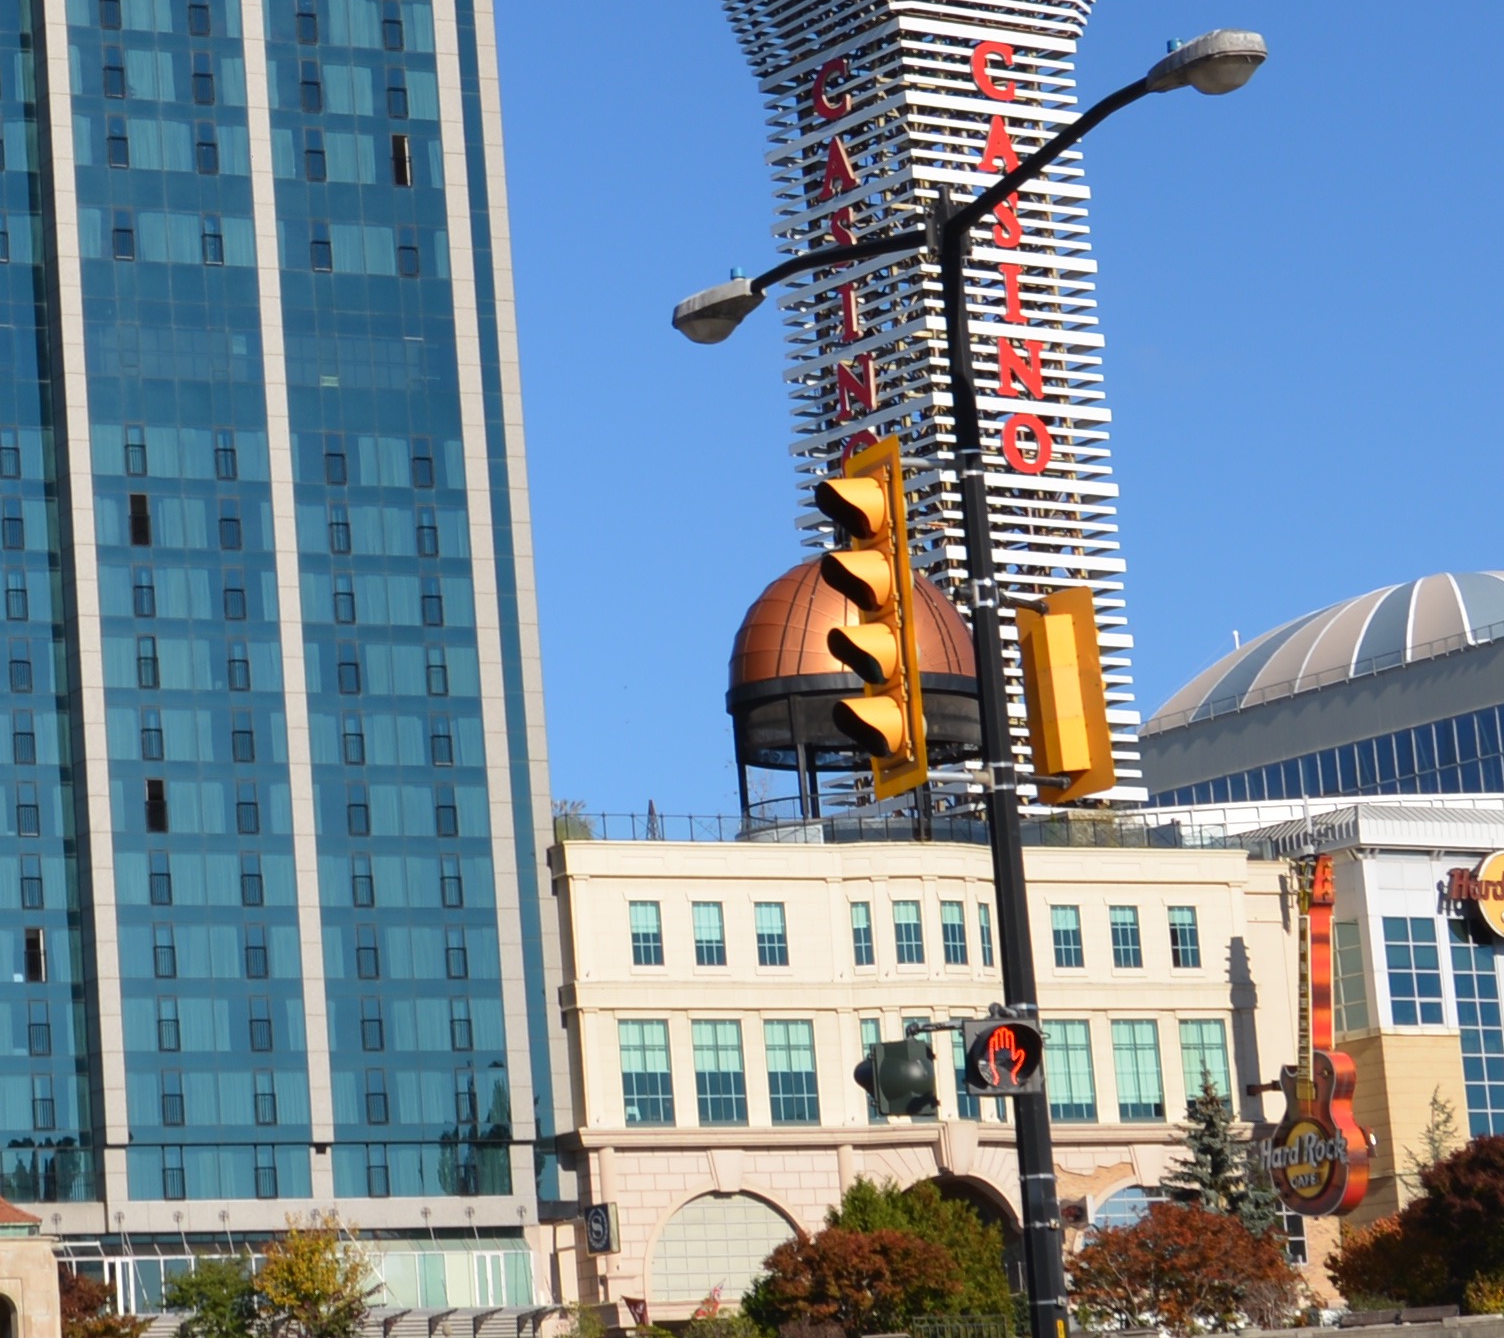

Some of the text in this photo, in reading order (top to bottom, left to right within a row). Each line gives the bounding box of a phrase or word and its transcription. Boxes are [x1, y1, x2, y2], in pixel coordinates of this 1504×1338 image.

[969, 39, 1053, 475] CASINO
[1259, 1128, 1349, 1171] Hard Rock
[1291, 1172, 1318, 1190] CAFE
